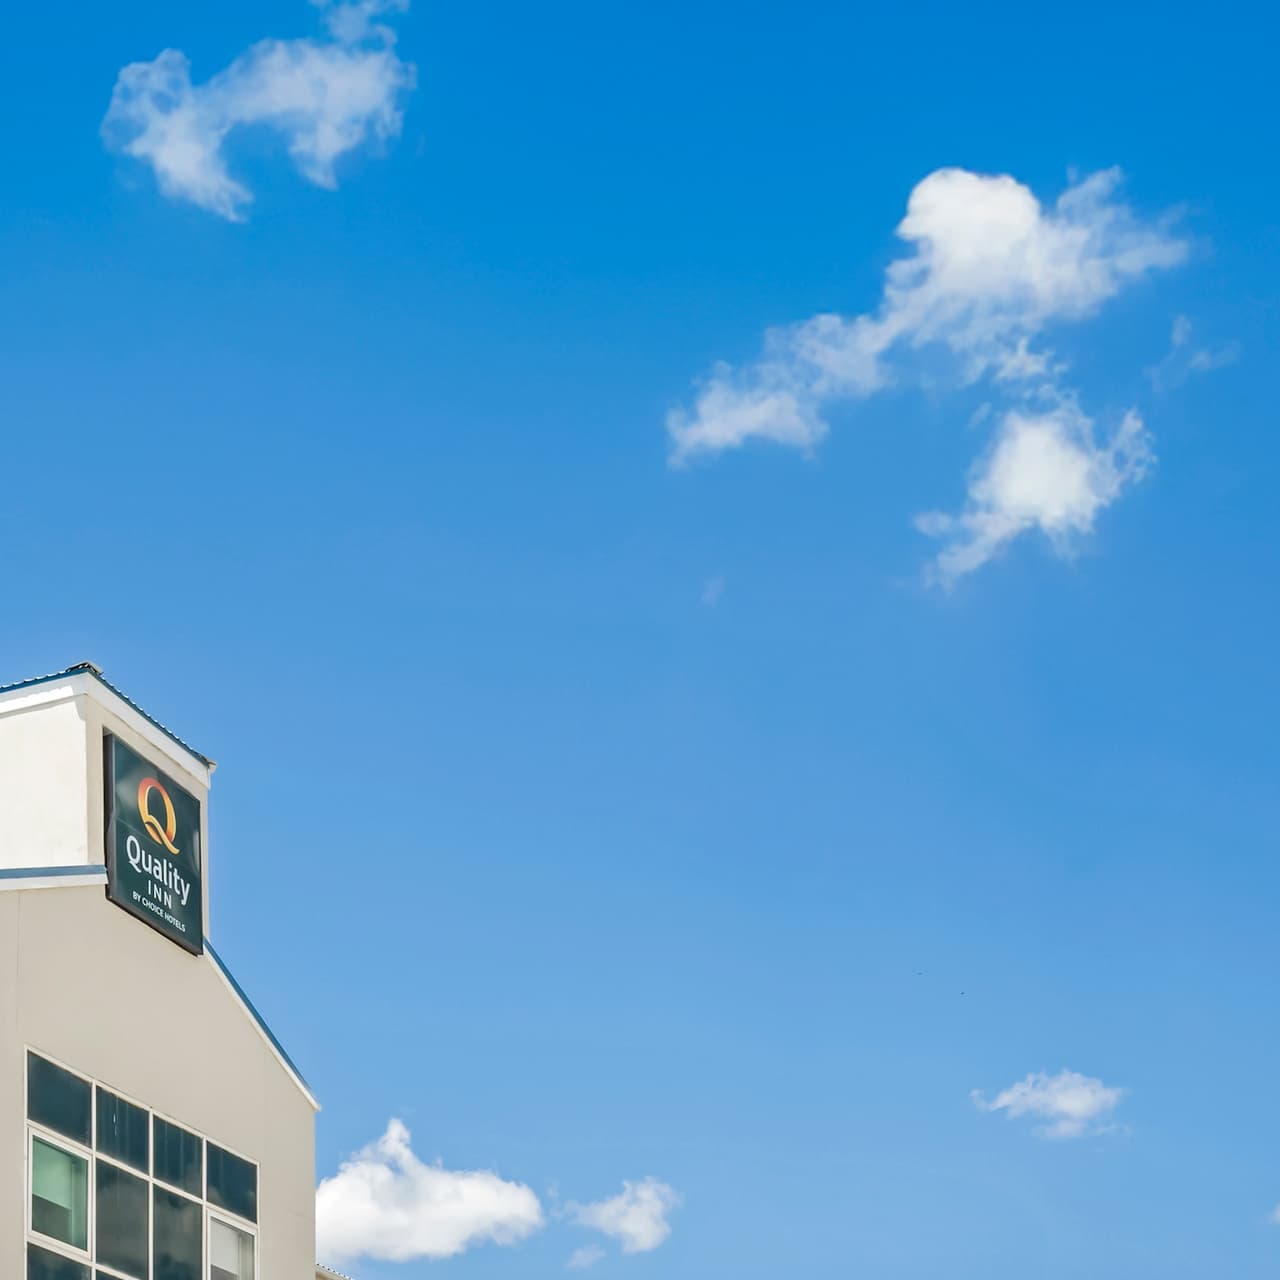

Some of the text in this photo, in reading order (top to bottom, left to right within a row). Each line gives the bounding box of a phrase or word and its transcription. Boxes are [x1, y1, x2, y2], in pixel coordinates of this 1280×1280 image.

[137, 777, 180, 855] Q
[126, 835, 190, 906] Quality
[148, 880, 172, 909] INN
[132, 891, 186, 932] BY CHOICE HOTELS
